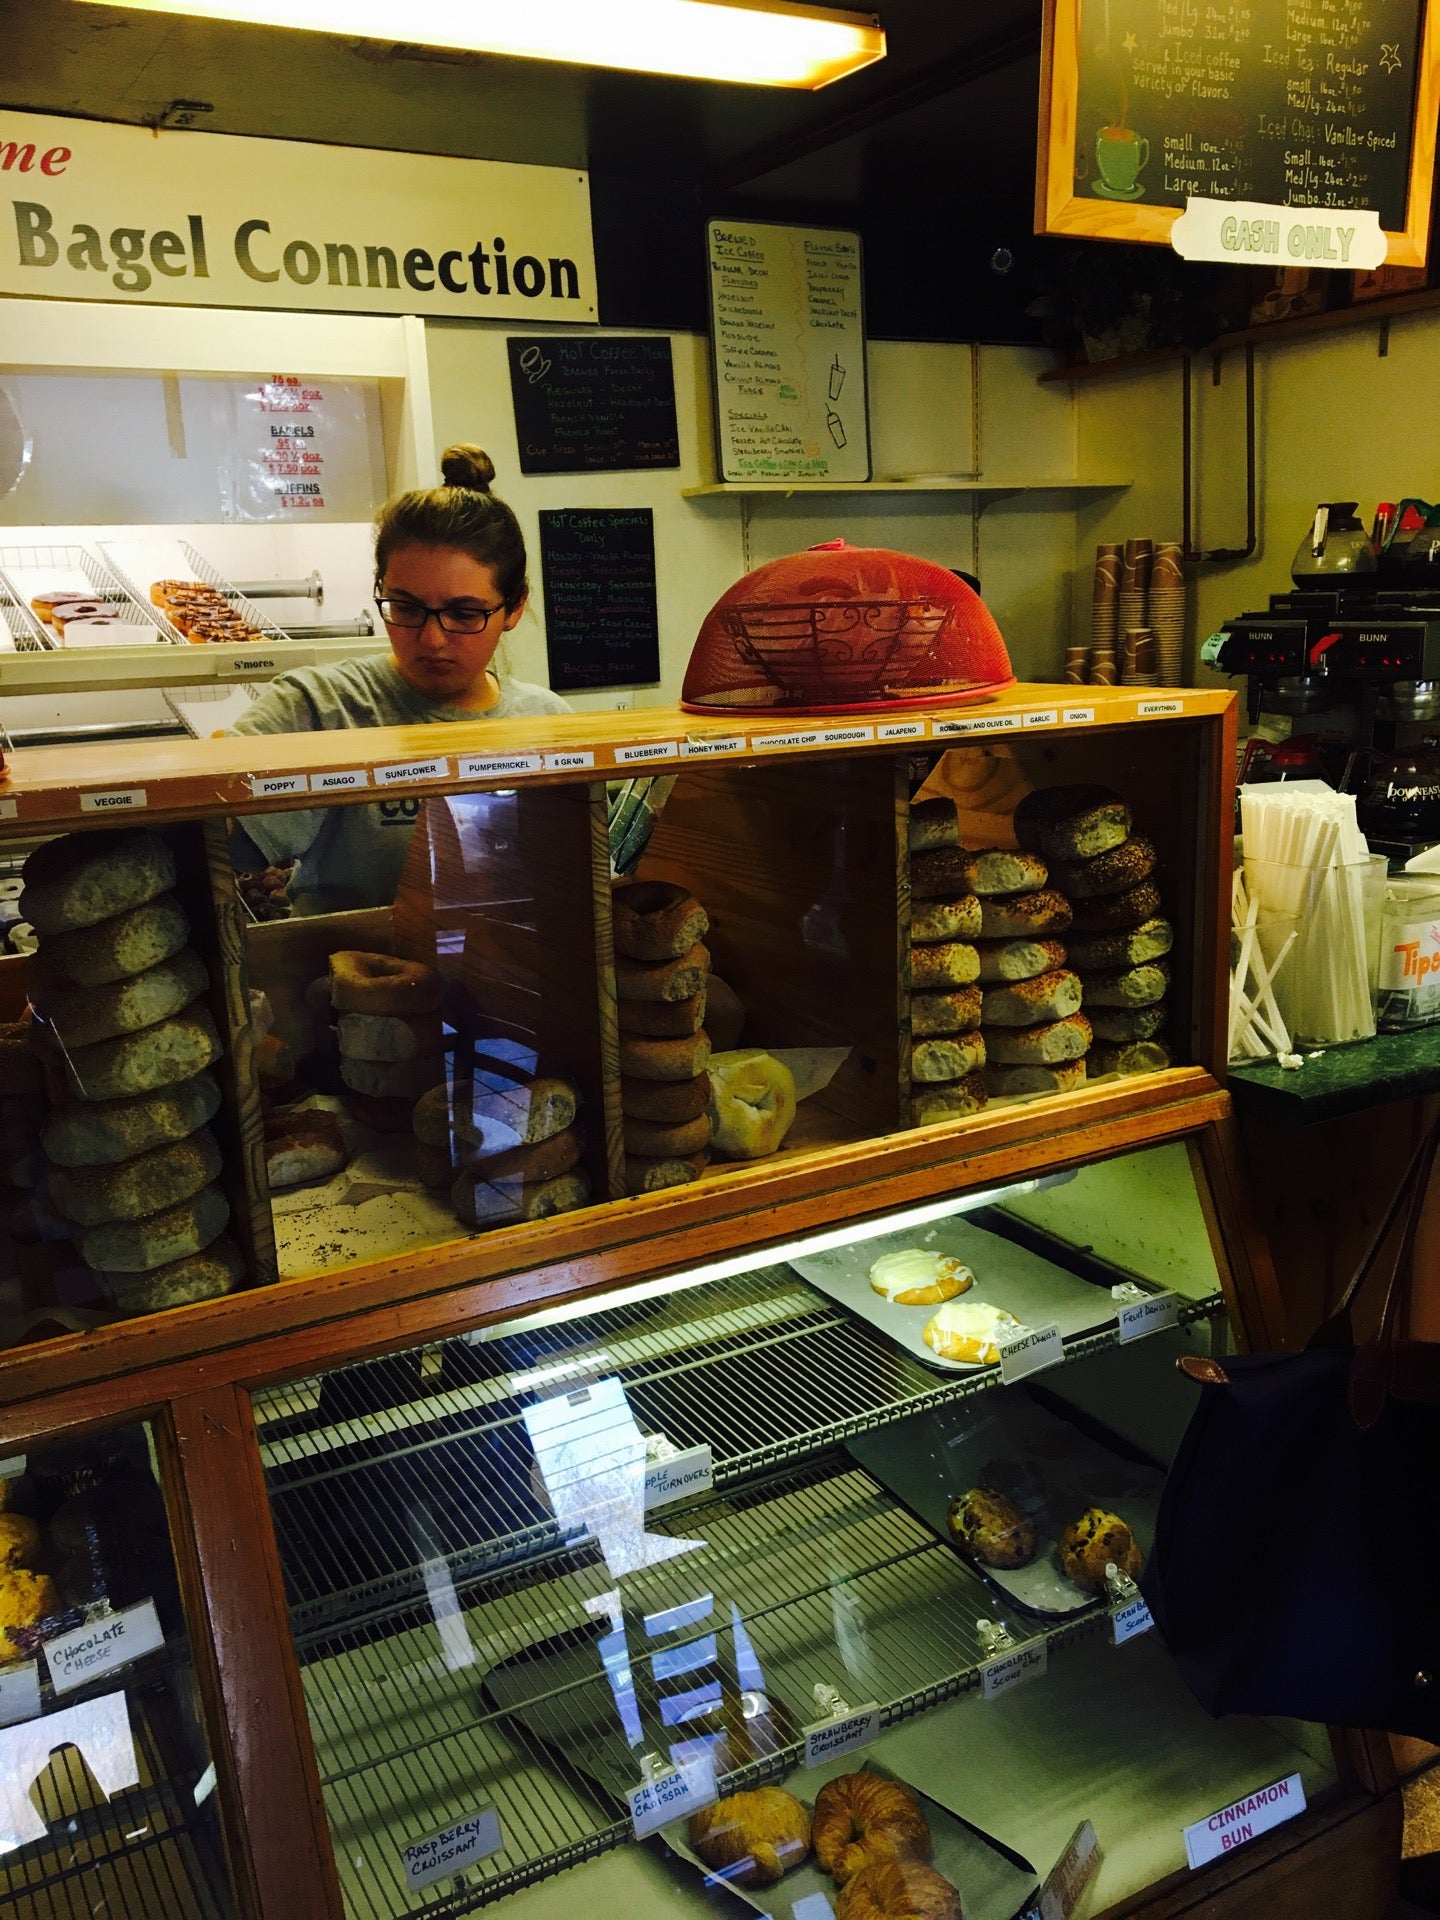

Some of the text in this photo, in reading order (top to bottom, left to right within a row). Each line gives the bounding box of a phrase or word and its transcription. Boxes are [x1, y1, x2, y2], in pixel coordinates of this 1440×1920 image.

[1158, 15, 1194, 39] Jumbo
[1175, 41, 1202, 65] Iced
[1172, 65, 1182, 75] in
[1185, 67, 1206, 83] your
[1208, 68, 1236, 82] basic
[1326, 52, 1369, 81] Regular
[1325, 123, 1357, 146] Vanilla
[1366, 129, 1396, 152] Spiced
[1220, 215, 1356, 262] CASH ONLY
[12, 199, 582, 300] Bagel Connection
[274, 482, 321, 494] FFINS
[1249, 632, 1273, 641] BUNN
[1359, 633, 1388, 642] BUNN
[234, 658, 275, 670] S'mores
[1143, 704, 1177, 713] EVERYTHING
[973, 721, 986, 730] AND
[986, 720, 1003, 729] OLIVE
[1004, 719, 1014, 727] OIL
[1030, 715, 1051, 724] GARLIC
[801, 735, 817, 744] CHIP
[824, 731, 866, 742] SOURDOUGH
[884, 727, 918, 737] JALAPENO
[624, 746, 669, 759] BLUEBERRY
[688, 742, 738, 755] HONEY WHEAT
[384, 764, 437, 780] SUNFLOWER
[468, 760, 531, 773] PUMPERNICKEL
[554, 759, 560, 767] 8
[263, 780, 296, 792] POPPY
[321, 776, 356, 787] ASIAGO
[94, 796, 133, 807] VEGGIE
[1001, 1338, 1030, 1359] CHEESE
[644, 1469, 669, 1490] PPLE
[654, 1467, 710, 1493] TURNOVERS
[53, 1620, 126, 1666] CHOCOLATE
[63, 1645, 112, 1676] CHEESE
[991, 1669, 1022, 1690] SCONE
[810, 1715, 872, 1746] STRAWBERRY
[811, 1727, 865, 1757] CROISSANT
[633, 1771, 684, 1805] CHCOLA
[634, 1783, 690, 1818] CROISSAN
[1207, 1780, 1290, 1832] CINNAMON
[405, 1817, 482, 1861] RASPBERRY
[1220, 1822, 1254, 1851] BUN
[411, 1836, 478, 1876] CROISSANT
